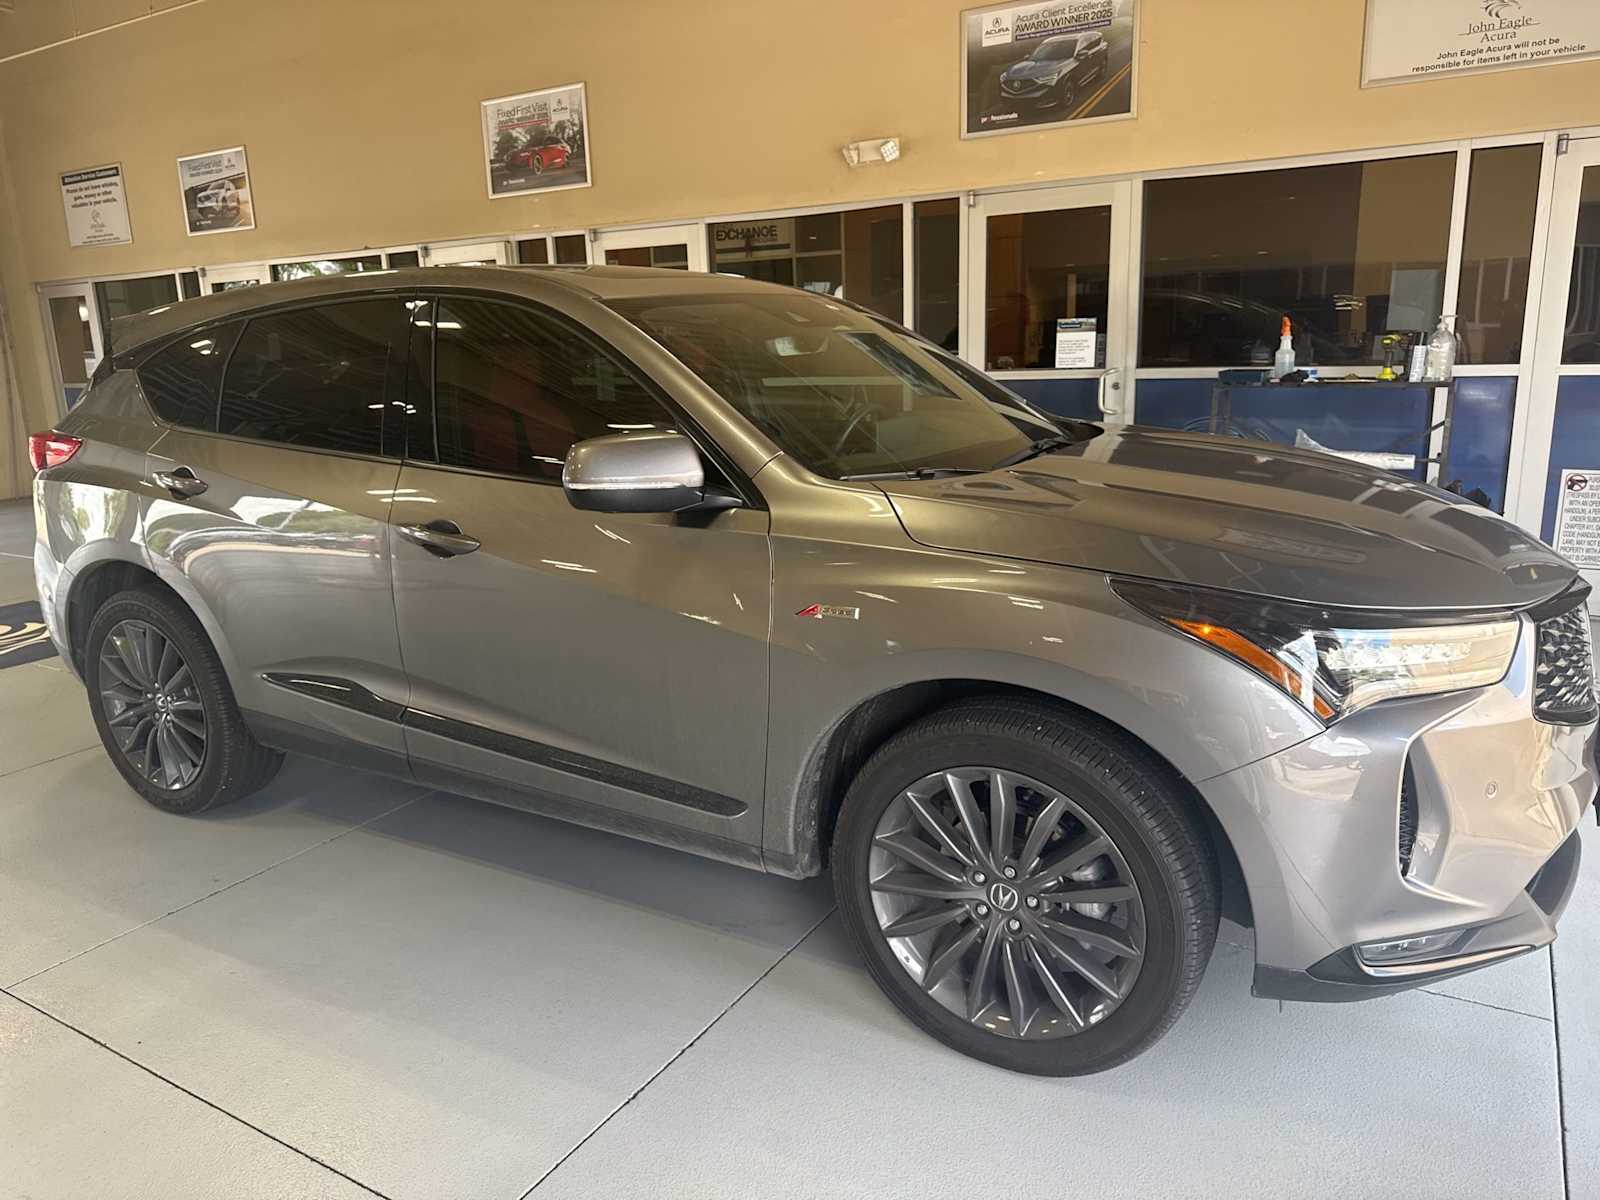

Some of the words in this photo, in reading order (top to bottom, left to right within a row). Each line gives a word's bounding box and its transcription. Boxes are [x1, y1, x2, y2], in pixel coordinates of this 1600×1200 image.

[1015, 20, 1050, 33] AWARD
[1051, 12, 1089, 27] WINNER
[1090, 8, 1113, 20] 2025
[1016, 14, 1040, 23] Acura
[1041, 8, 1066, 19] Client
[1068, 0, 1113, 14] Excellence
[984, 27, 1010, 36] ACURA
[1467, 20, 1496, 35] John
[1499, 16, 1533, 31] Eagle
[1480, 30, 1517, 43] Acura
[1412, 60, 1461, 73] responsible
[1463, 58, 1475, 67] for
[1477, 54, 1501, 65] items
[1503, 52, 1517, 61] left
[1519, 50, 1528, 59] in
[1529, 48, 1551, 60] your
[1553, 43, 1586, 55] vehicle
[1436, 51, 1458, 60] John
[1460, 48, 1484, 58] Eagle
[1485, 44, 1512, 54] Acura
[1514, 40, 1530, 50] will
[1531, 39, 1547, 47] not
[1548, 36, 1560, 45] be
[716, 225, 777, 241] EXCHANGE
